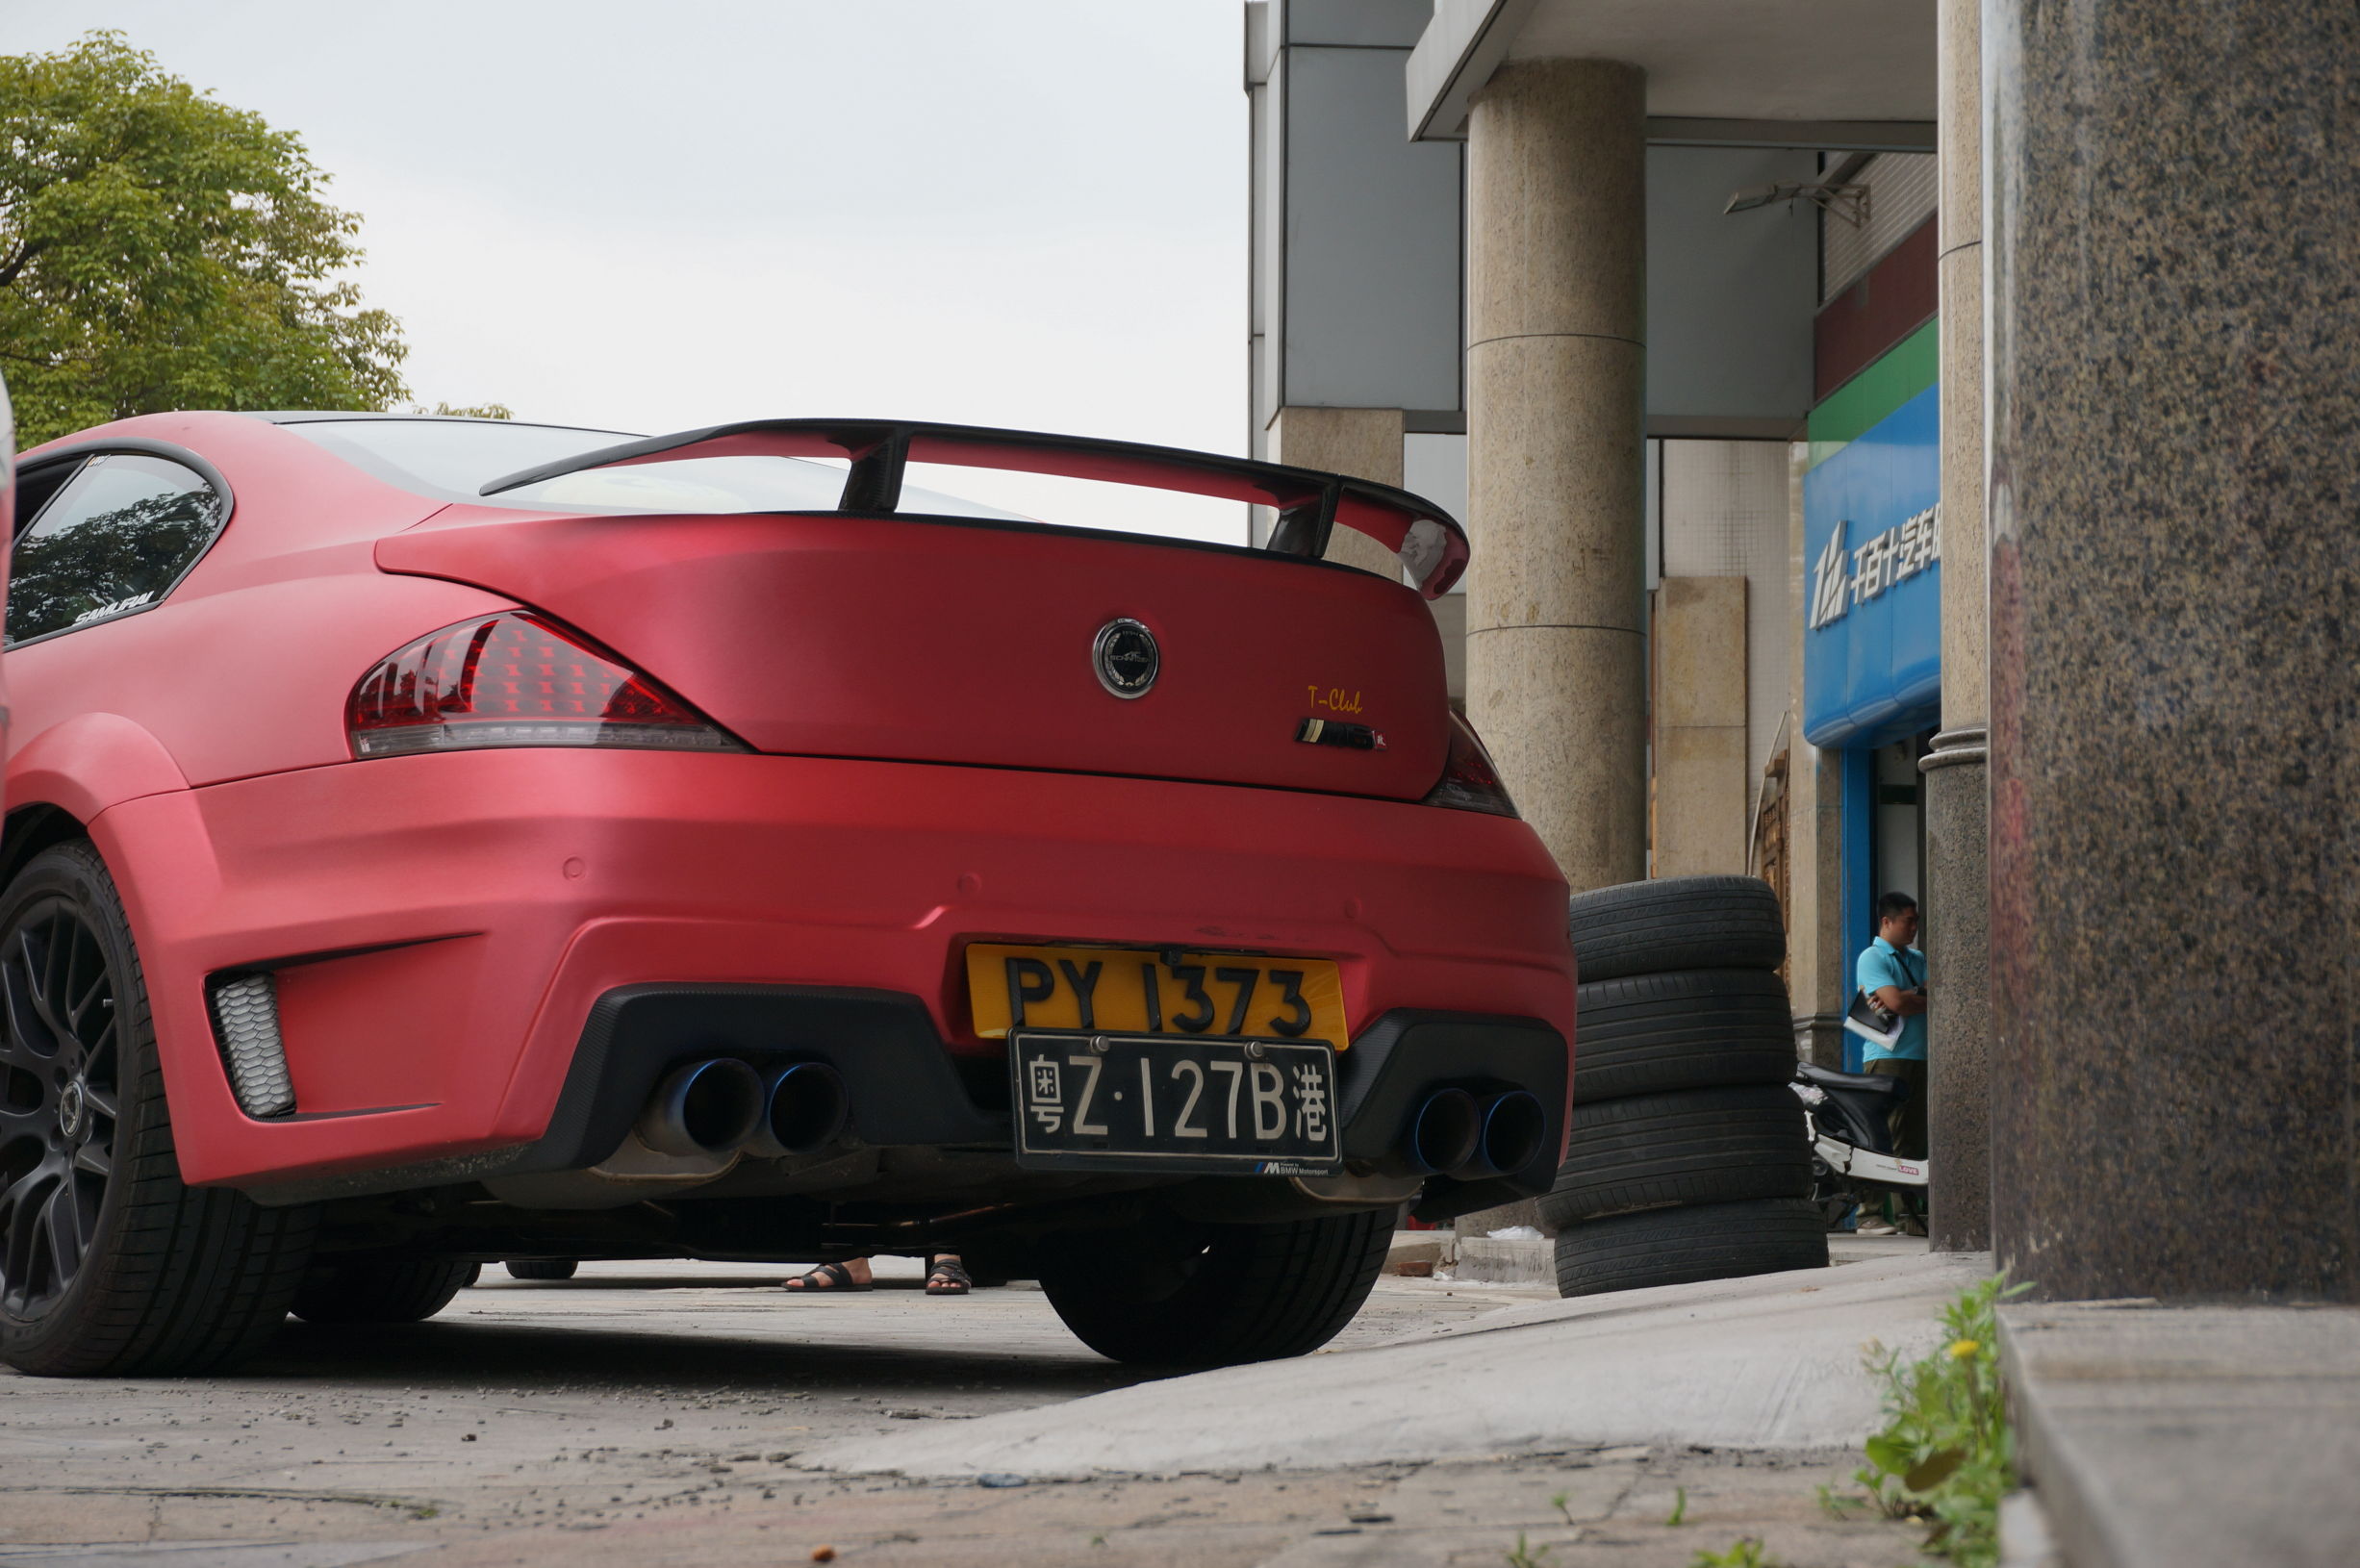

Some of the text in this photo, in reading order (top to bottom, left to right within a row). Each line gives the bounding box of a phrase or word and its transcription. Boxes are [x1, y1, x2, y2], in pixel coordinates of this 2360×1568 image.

[75, 590, 155, 623] SAMURAI
[1308, 685, 1362, 714] T-Club
[1005, 956, 1312, 1036] PY 1373
[1281, 1166, 1329, 1176] BMW Motorsport
